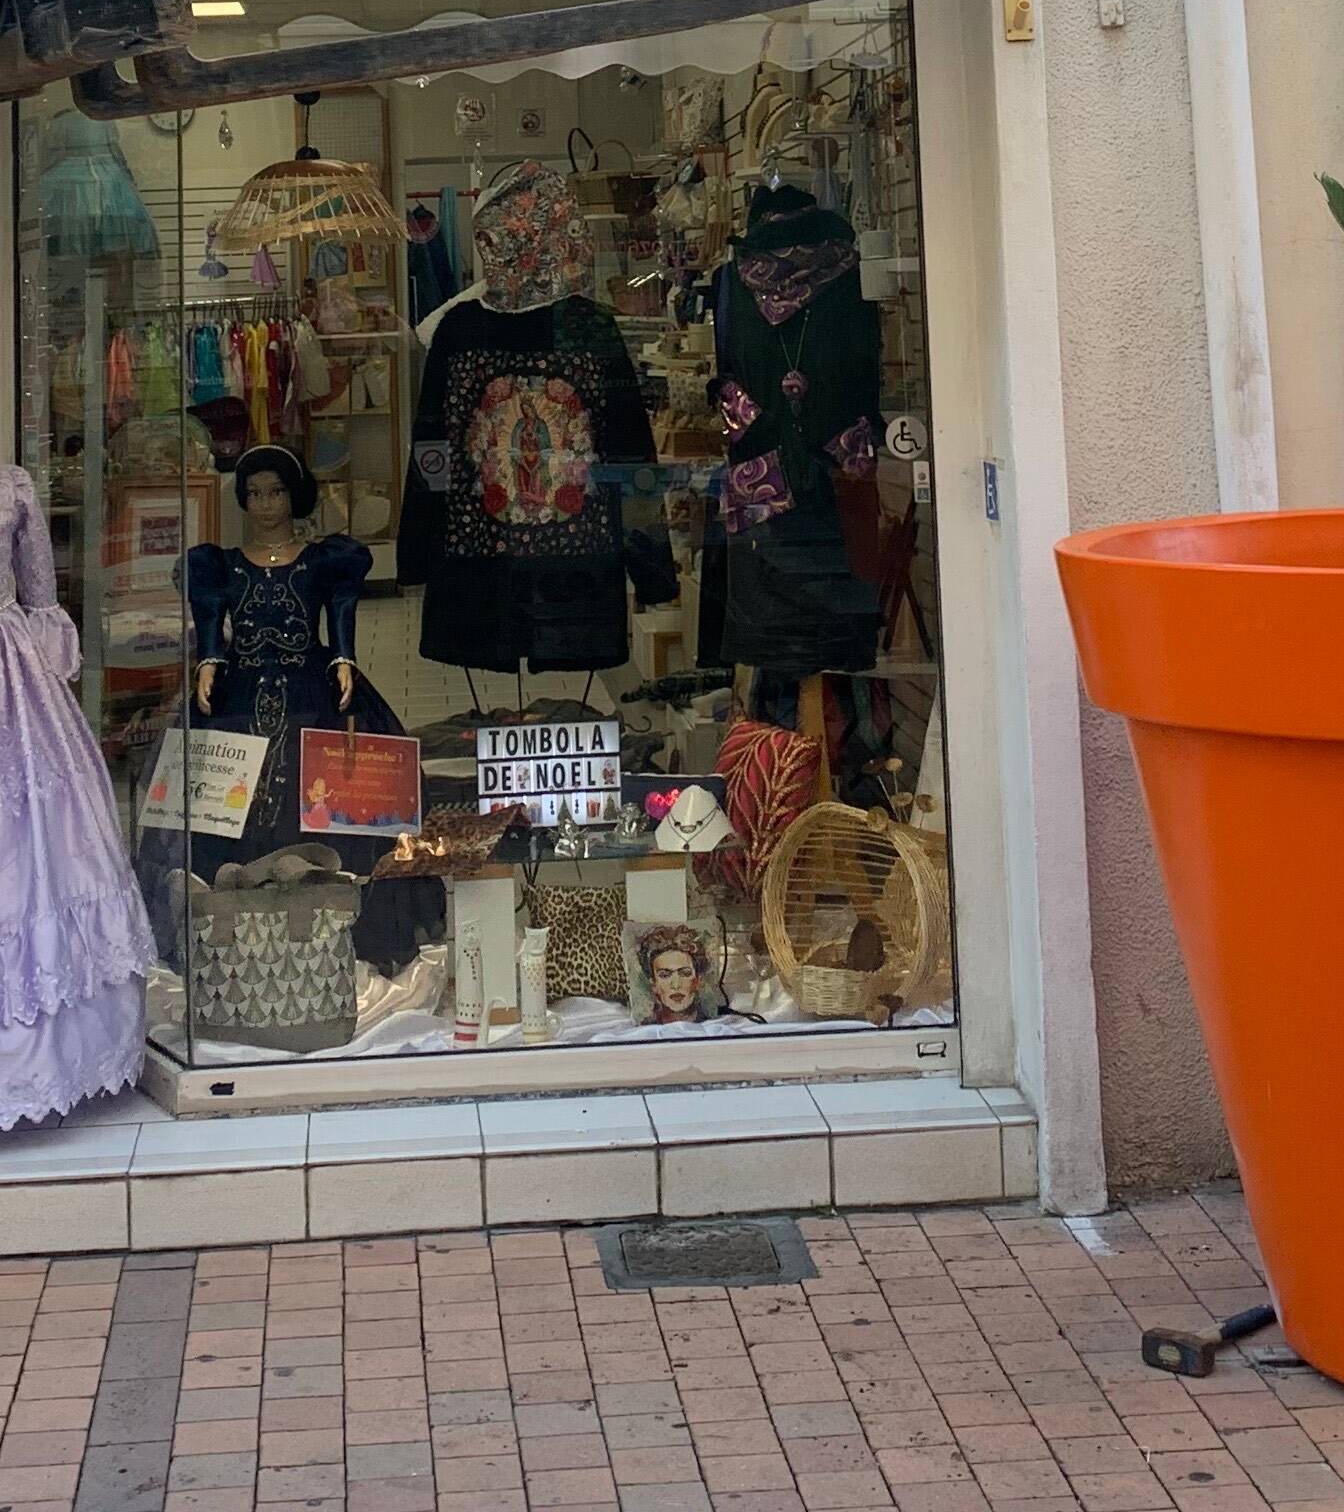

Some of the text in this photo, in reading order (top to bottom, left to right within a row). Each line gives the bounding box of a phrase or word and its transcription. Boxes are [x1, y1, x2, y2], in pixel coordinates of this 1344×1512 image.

[489, 724, 605, 756] TOMBOLA
[483, 761, 597, 791] DE NOEL
